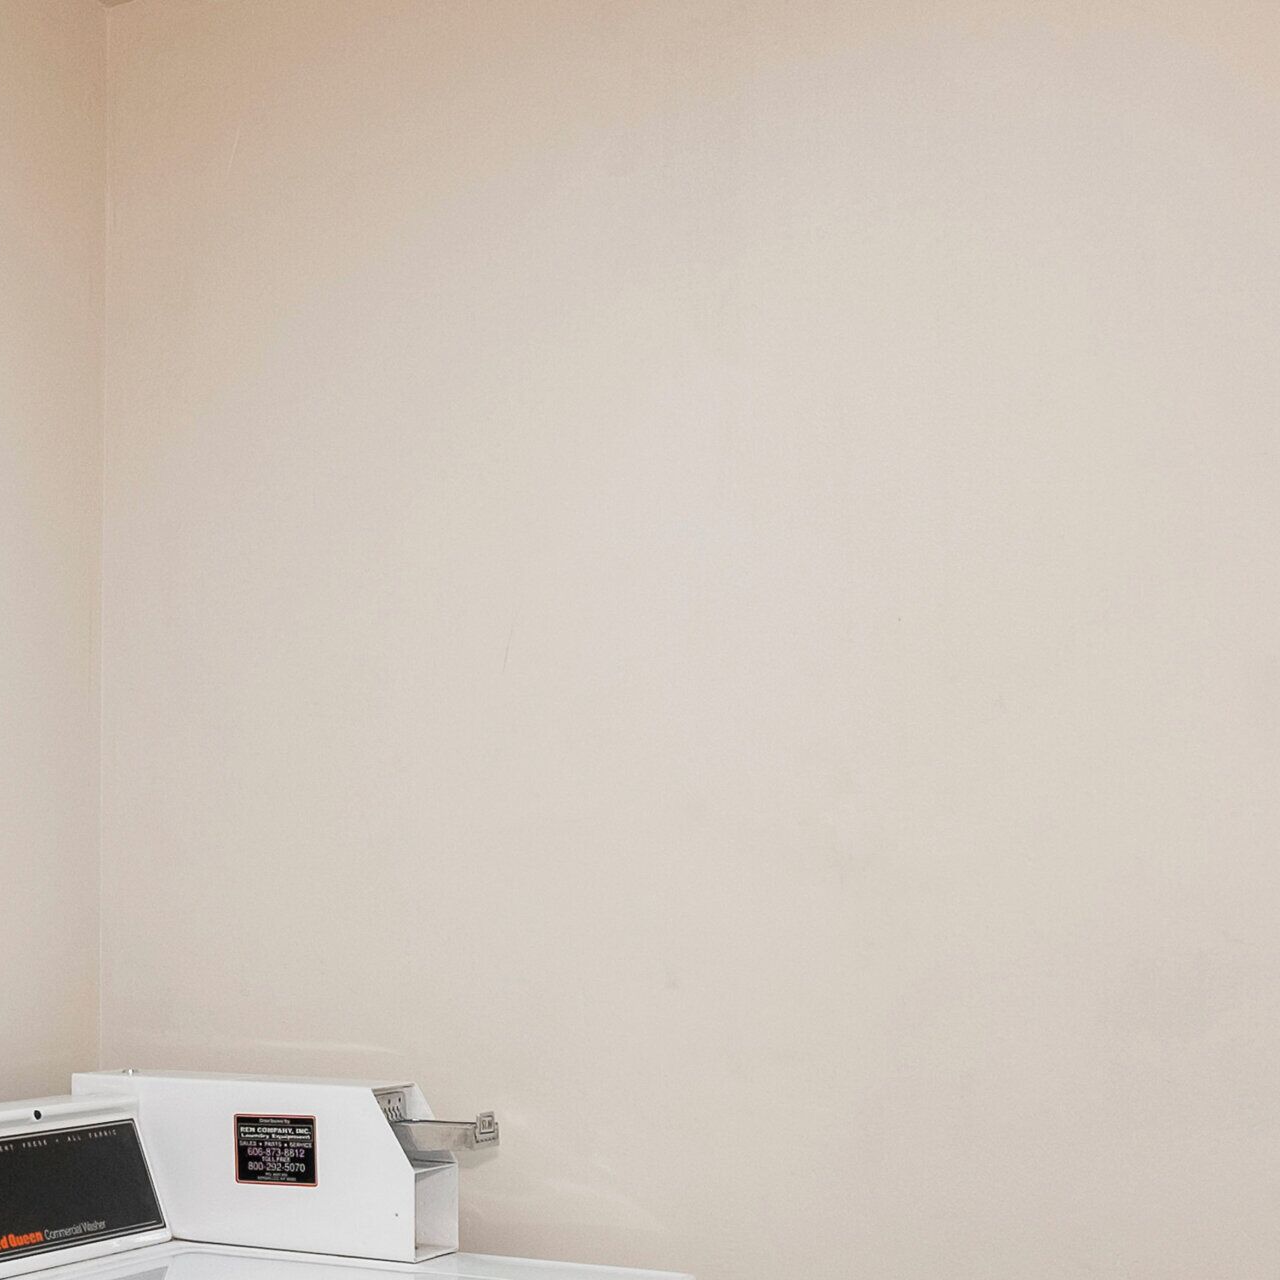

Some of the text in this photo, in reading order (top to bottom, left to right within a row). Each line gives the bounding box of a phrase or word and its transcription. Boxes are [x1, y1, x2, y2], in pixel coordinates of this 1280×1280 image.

[247, 1162, 306, 1172] 800-292-5070
[8, 1230, 44, 1248] Queen
[44, 1224, 82, 1240] Commercial
[81, 1220, 106, 1233] Washer
